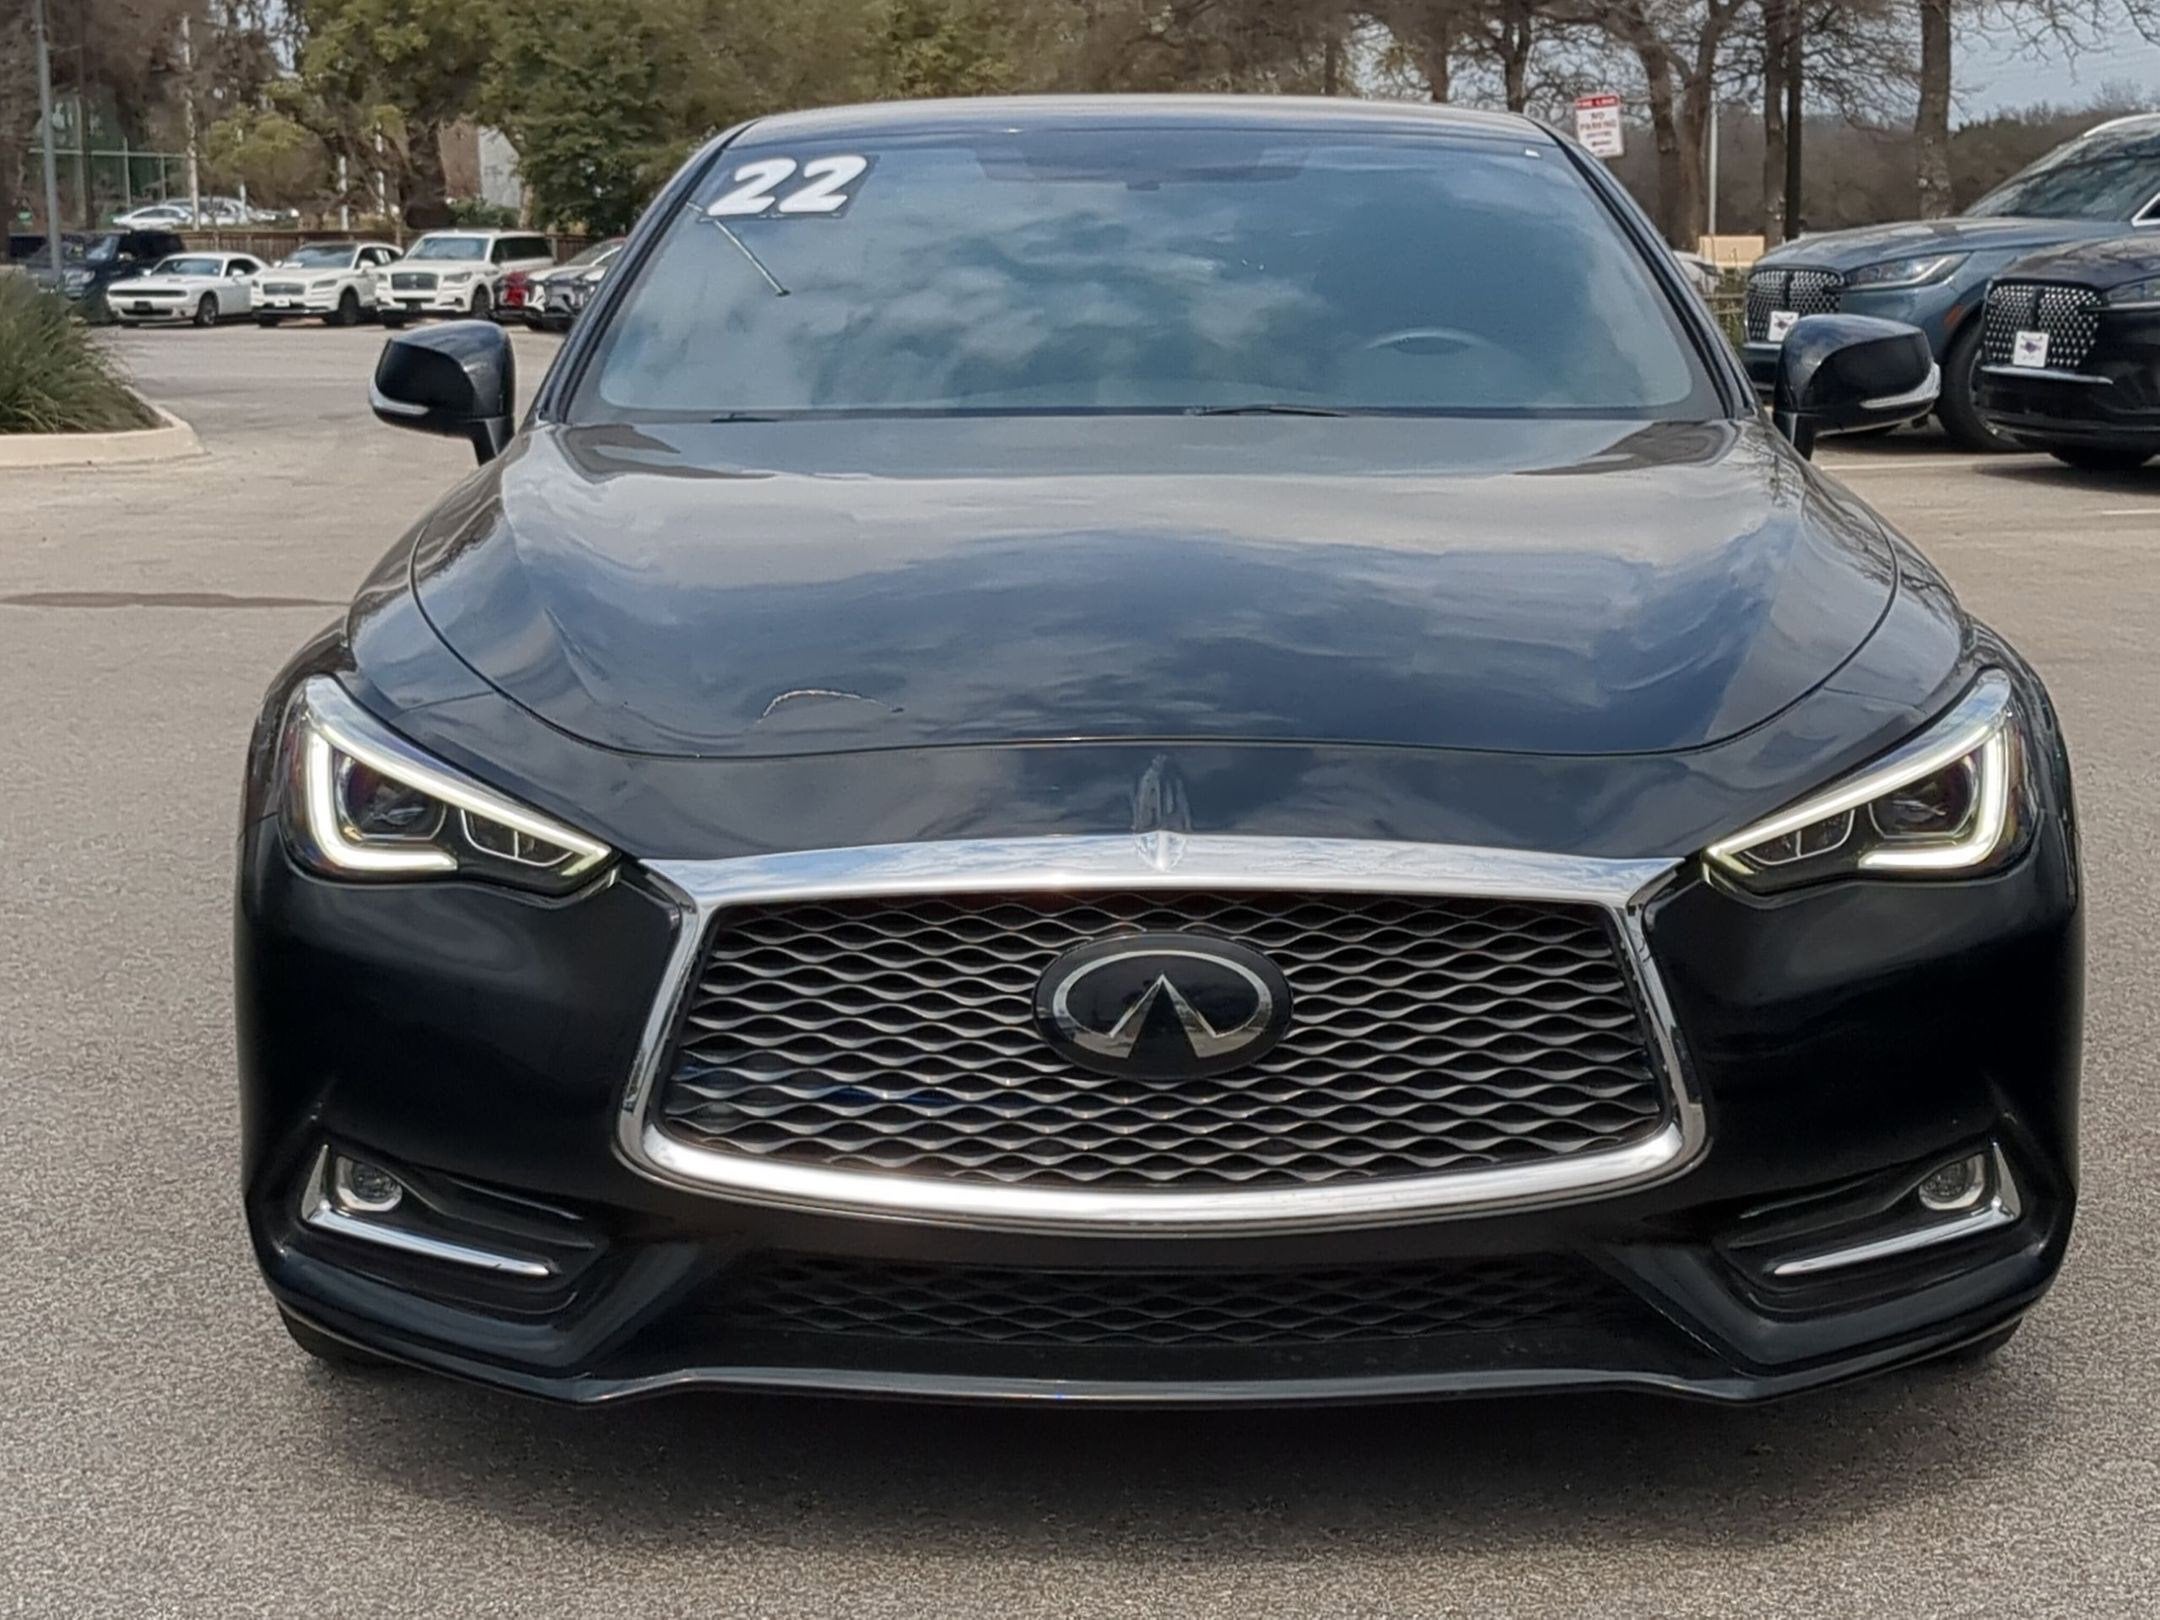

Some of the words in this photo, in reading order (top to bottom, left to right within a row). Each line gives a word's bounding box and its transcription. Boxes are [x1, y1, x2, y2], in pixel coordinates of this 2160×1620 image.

[1591, 111, 1605, 119] NO
[1580, 119, 1617, 131] PARKING
[707, 155, 867, 216] 22
